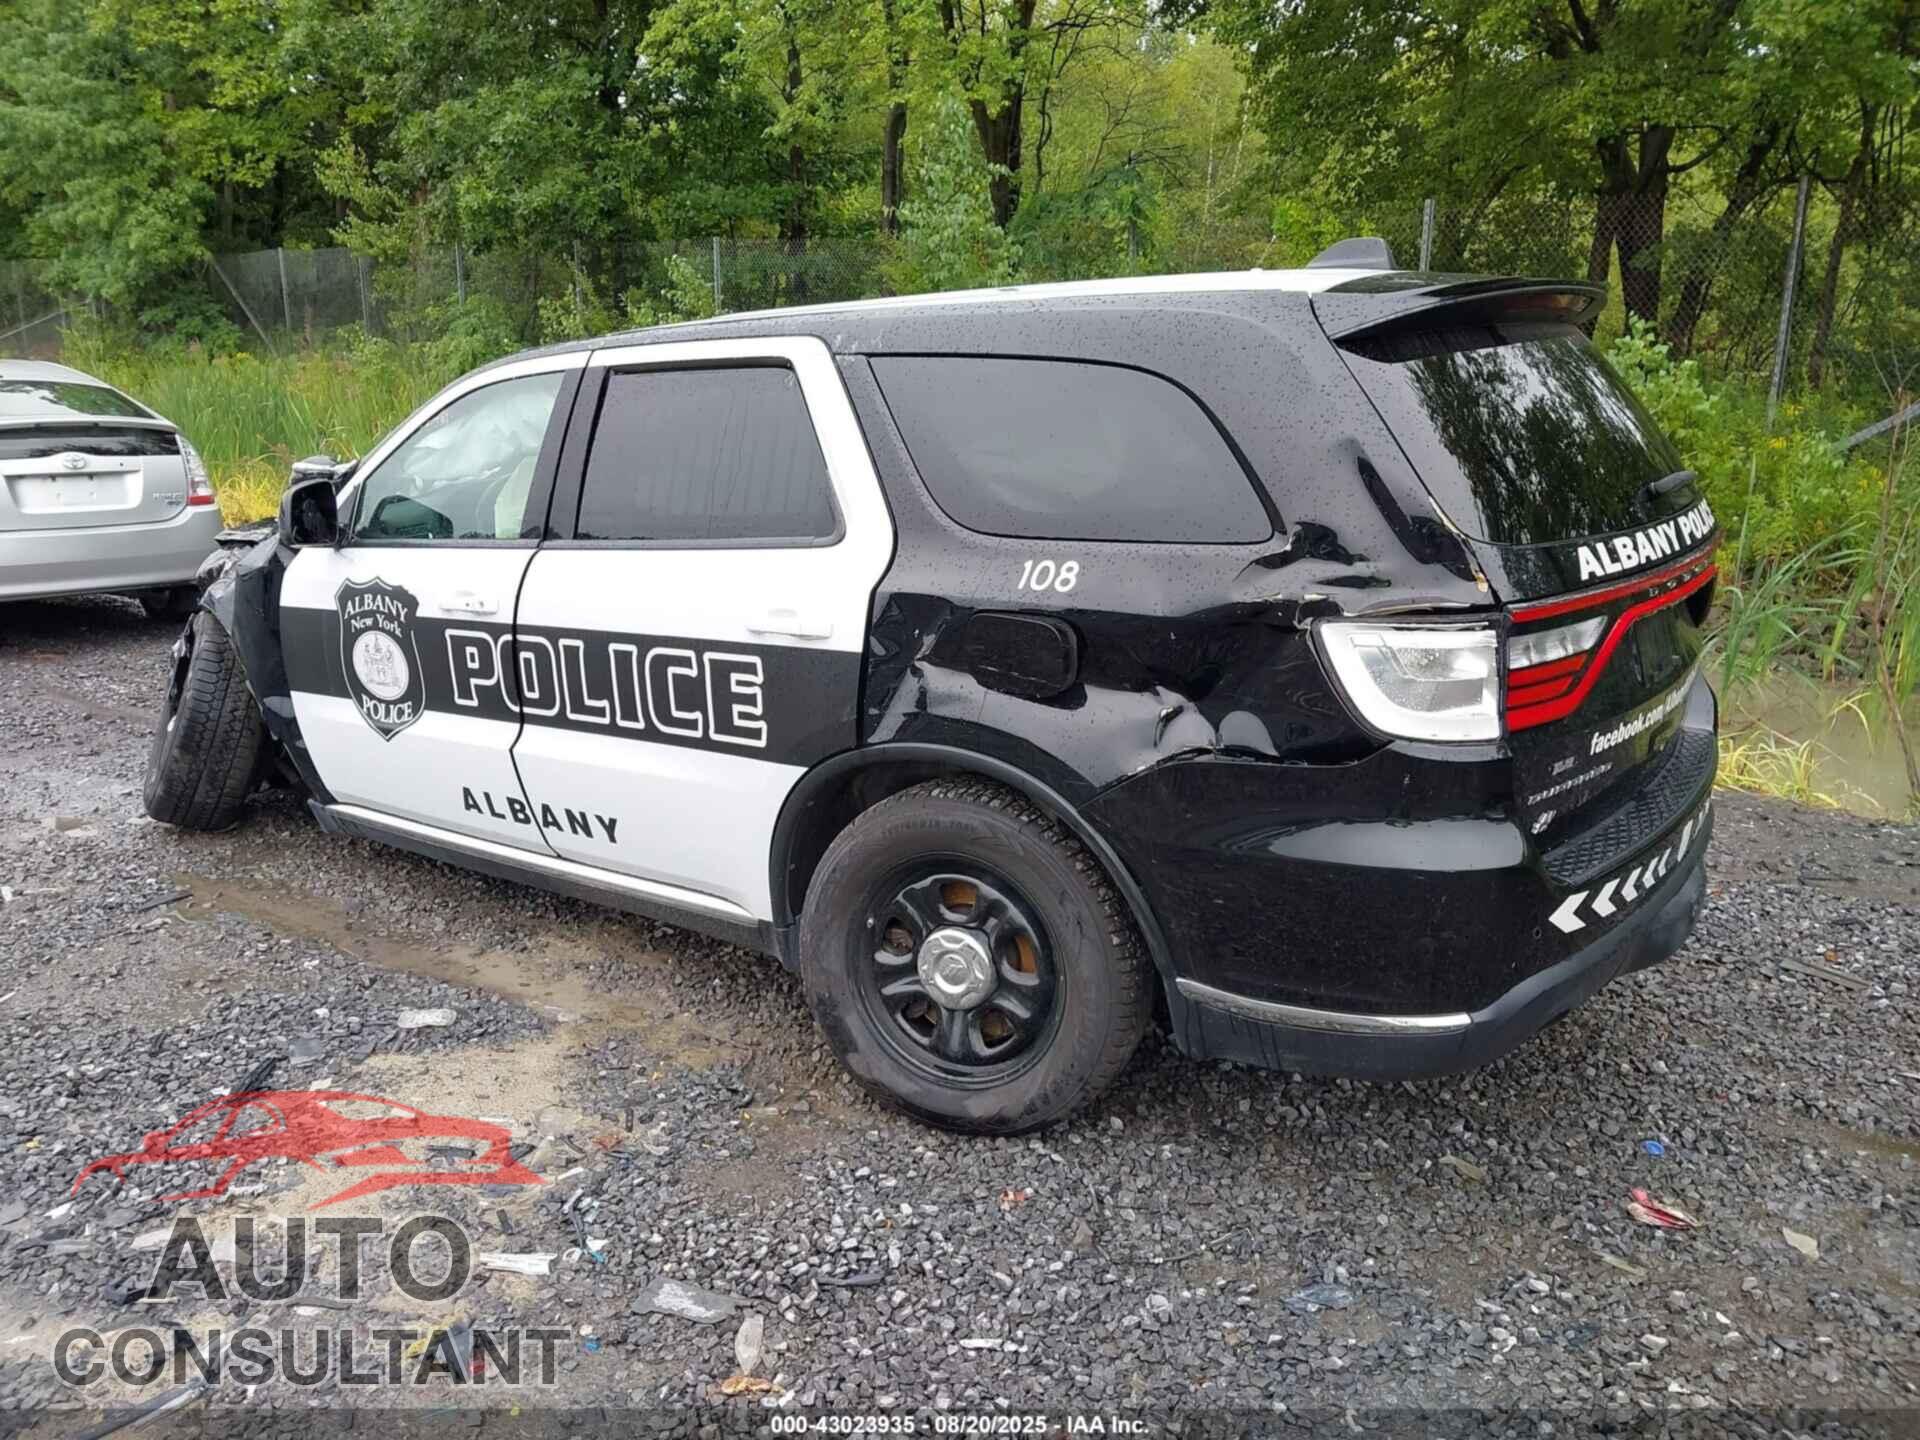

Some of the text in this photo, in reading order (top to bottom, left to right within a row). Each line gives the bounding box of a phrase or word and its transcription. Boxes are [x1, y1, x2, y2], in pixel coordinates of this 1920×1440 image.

[1577, 519, 1681, 581] ALBANY
[1676, 497, 1715, 546] POLIC
[1017, 559, 1080, 593] 108
[344, 593, 409, 624] ALBANY
[351, 613, 402, 638] New York
[361, 693, 414, 724] POLICE
[444, 628, 768, 748] POLICE
[1590, 704, 1664, 756] facebook.com
[462, 786, 618, 844] ALBANY
